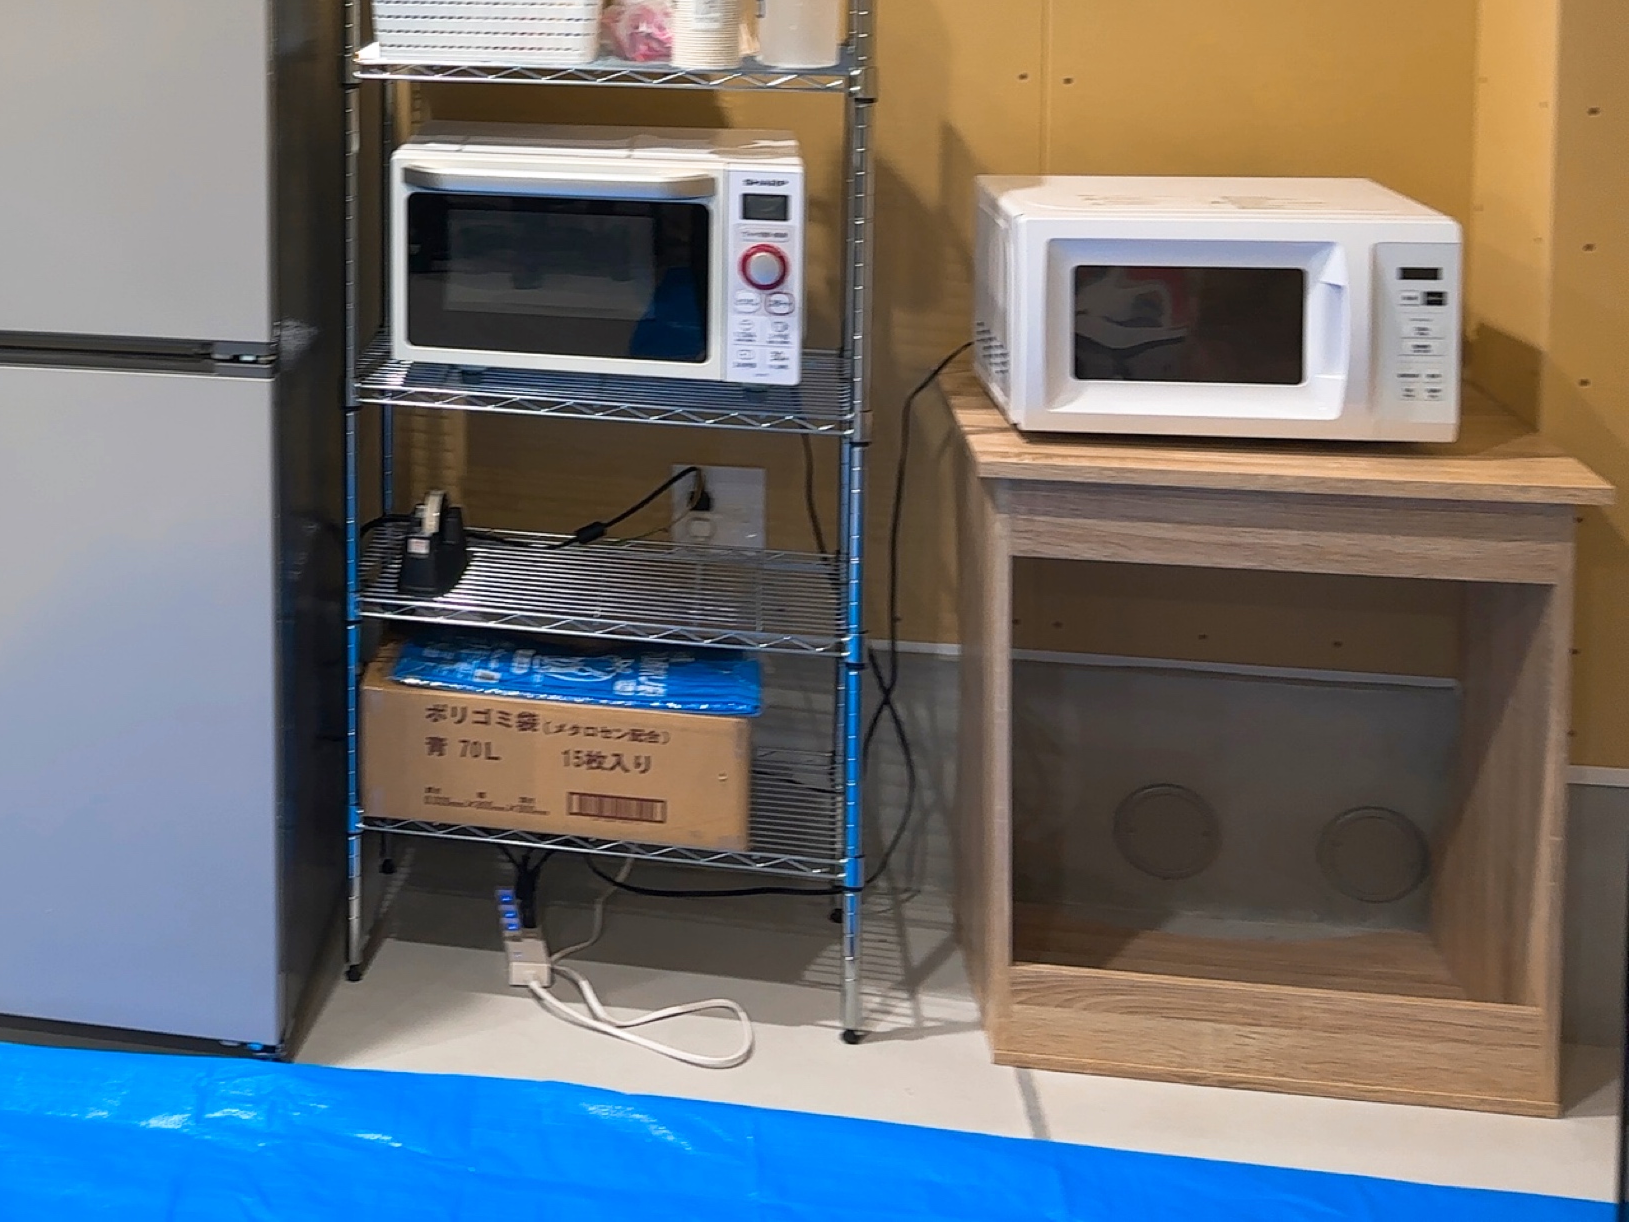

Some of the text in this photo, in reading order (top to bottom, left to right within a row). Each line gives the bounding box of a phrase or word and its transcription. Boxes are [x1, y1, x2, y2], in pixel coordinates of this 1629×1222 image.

[425, 736, 653, 774] 青 70L 15枚入り
